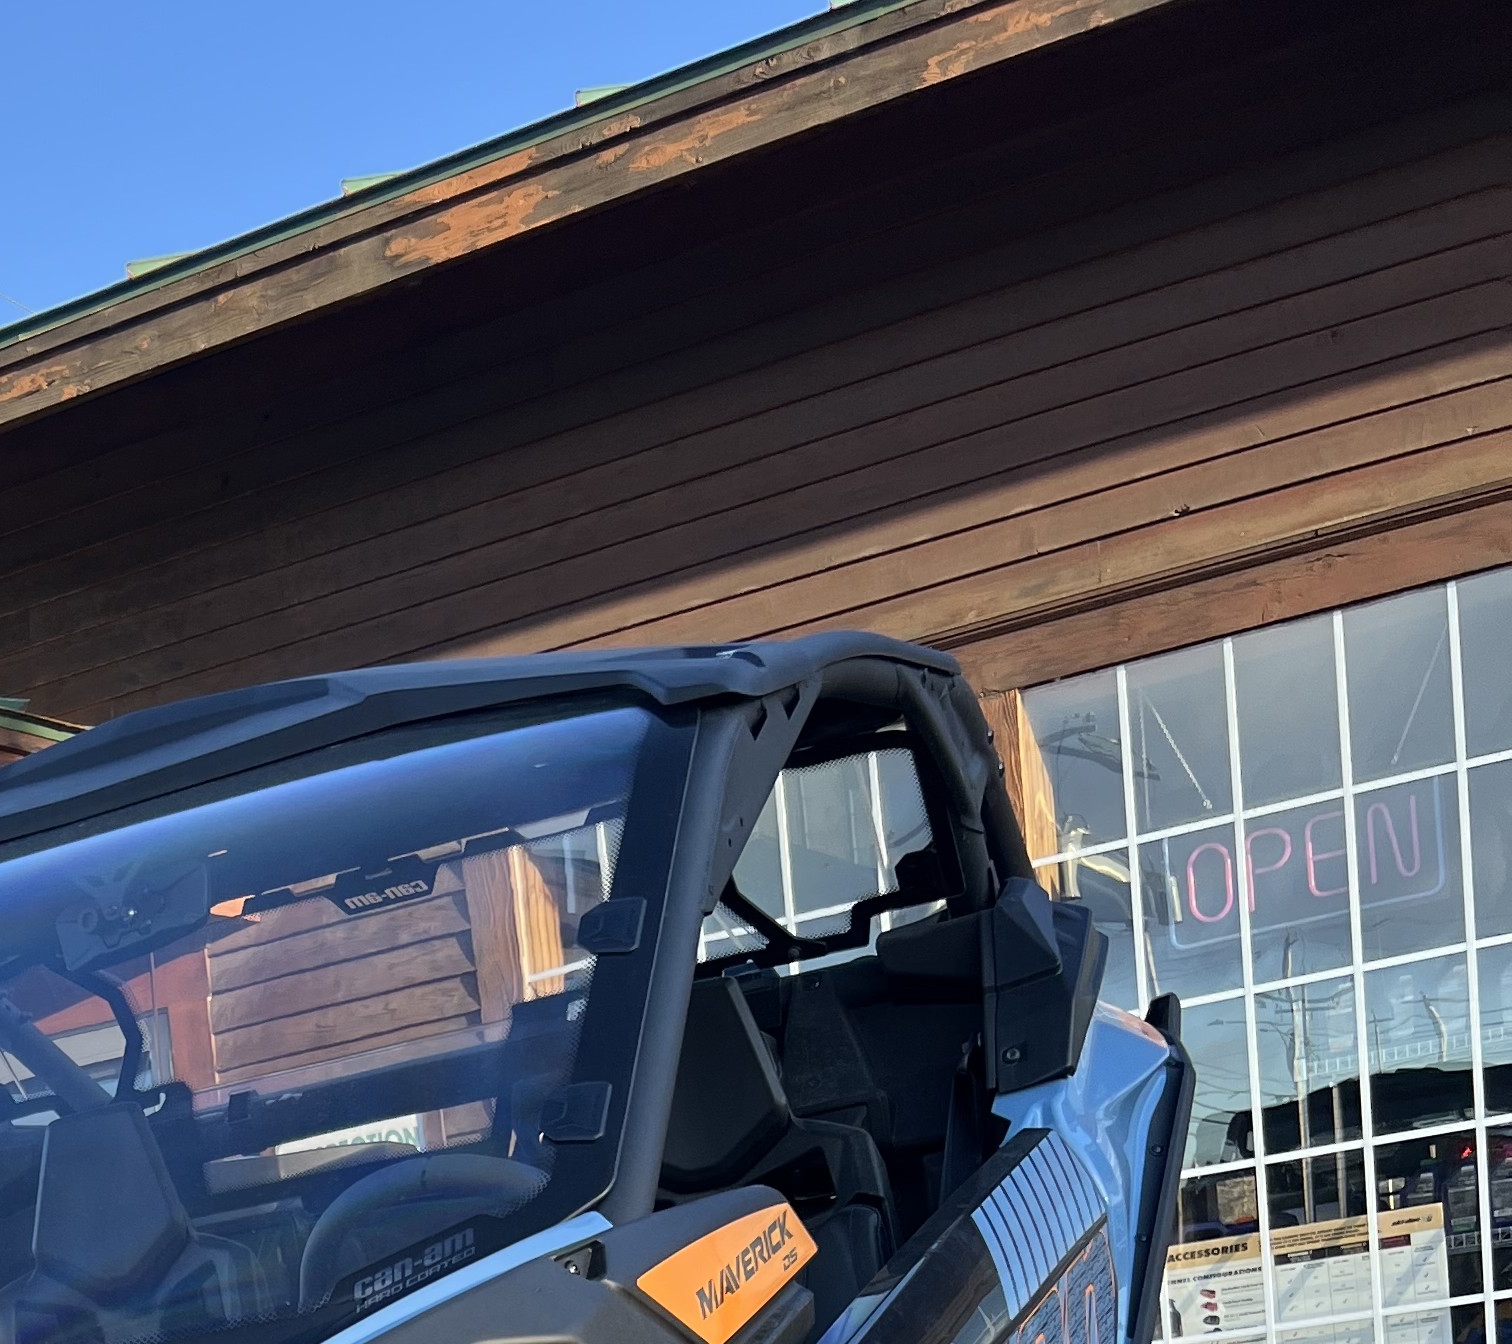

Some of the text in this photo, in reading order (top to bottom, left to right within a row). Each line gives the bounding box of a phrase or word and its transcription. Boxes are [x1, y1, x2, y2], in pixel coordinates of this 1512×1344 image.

[1186, 794, 1421, 923] OPEN
[354, 1228, 474, 1299] can-am
[355, 1246, 476, 1313] HARD COATED
[696, 1209, 793, 1320] MAVERICK
[782, 1246, 798, 1271] DS
[1167, 1242, 1249, 1263] ACCESSORIES
